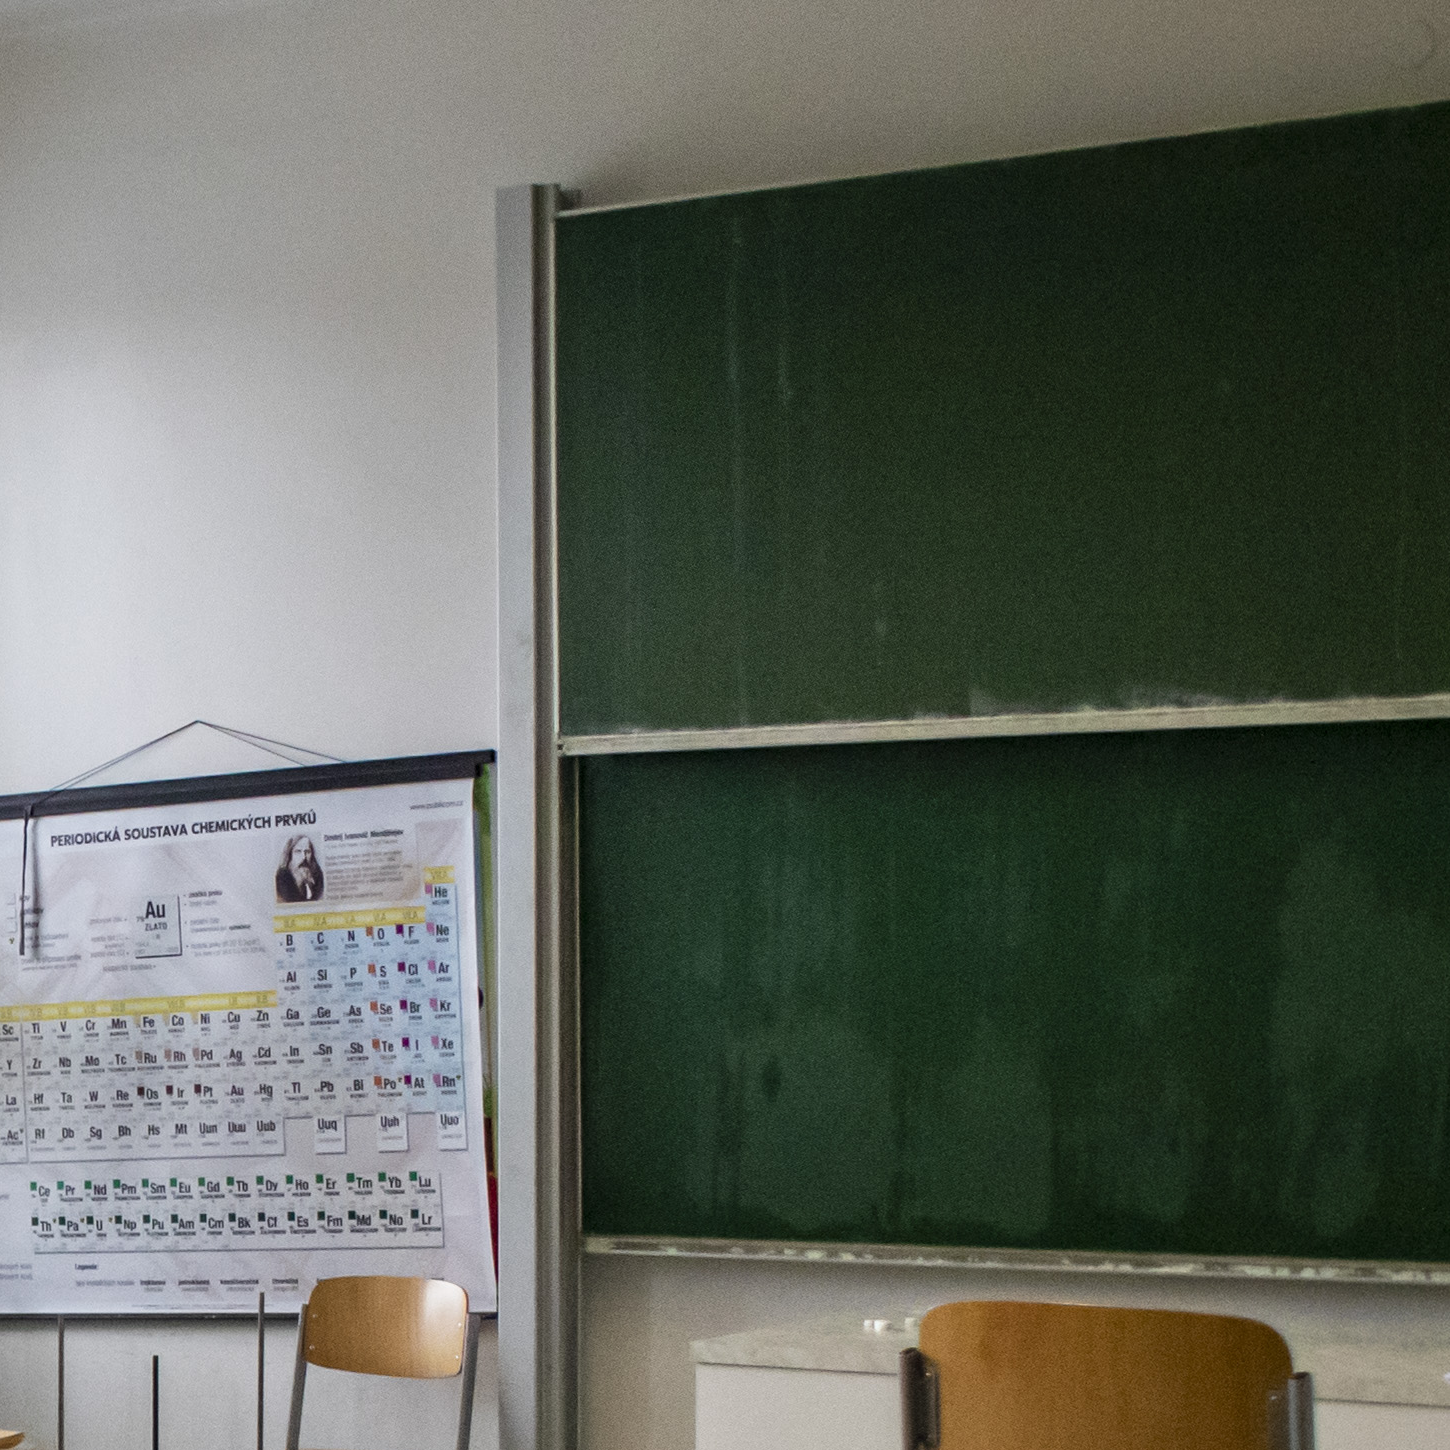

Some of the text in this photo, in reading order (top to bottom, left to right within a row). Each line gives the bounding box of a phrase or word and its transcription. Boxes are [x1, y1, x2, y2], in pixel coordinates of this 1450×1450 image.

[50, 826, 121, 847] PERIODICKÁ
[124, 824, 188, 841] SOUSTAVA
[191, 814, 271, 835] CHEMICKÝCH
[434, 886, 448, 898] He
[145, 901, 166, 919] Au
[144, 922, 168, 932] ZLATO
[286, 924, 449, 946] B C N O F Ne
[286, 972, 296, 983] Al
[317, 969, 328, 981] Si
[350, 967, 357, 979] P
[380, 965, 387, 977] S
[438, 962, 449, 974] Ar
[2, 1024, 14, 1036] Sc
[60, 1021, 67, 1033] V
[85, 1019, 96, 1031] Cr
[111, 1018, 127, 1029] Mn
[143, 1016, 155, 1028] Fe
[171, 1015, 184, 1026] Co
[200, 1013, 210, 1025] Ni
[227, 1012, 241, 1023] Cu
[256, 1010, 269, 1022] Zn
[286, 1008, 300, 1020] Ga
[317, 1007, 331, 1018] Ge
[349, 1005, 362, 1017] As
[379, 1003, 393, 1015] Se
[409, 1001, 421, 1013] Br
[440, 1000, 451, 1012] Kr
[6, 1059, 12, 1071] Y
[32, 1058, 42, 1070] Zr
[58, 1056, 71, 1068] Nb
[85, 1055, 100, 1067] Mo
[115, 1054, 127, 1065] Tc
[143, 1052, 157, 1064] Ru
[173, 1051, 186, 1063] Rh
[201, 1050, 213, 1061] Pd
[229, 1048, 243, 1062] Ag
[258, 1047, 271, 1058] Cd
[289, 1045, 299, 1057] In
[318, 1044, 333, 1055] Sn
[350, 1042, 364, 1054] Sb
[381, 1041, 394, 1052] Te
[441, 1037, 454, 1049] Xe
[5, 1094, 17, 1105] La
[61, 1092, 73, 1103] Ta
[88, 1091, 99, 1102] W
[116, 1089, 130, 1100] Re
[145, 1088, 159, 1100] Os
[230, 1085, 244, 1096] Au
[259, 1083, 273, 1098] Hg
[320, 1081, 334, 1093] Pb
[384, 1078, 396, 1090] Po
[413, 1077, 425, 1089] At
[442, 1075, 456, 1087] Rn
[7, 1129, 19, 1140] Ac
[62, 1127, 75, 1138] Db
[90, 1126, 102, 1140] Sg
[118, 1125, 131, 1136] Bh
[148, 1124, 161, 1135] Hs
[257, 1119, 276, 1132] Uub
[380, 1115, 400, 1127] Uuh
[38, 1185, 50, 1197] Ce
[65, 1184, 75, 1196] Pr
[121, 1183, 137, 1195] Pm
[150, 1182, 166, 1194] Sm
[179, 1182, 191, 1193] Eu
[206, 1181, 220, 1193] Gd
[236, 1180, 248, 1192] Tb
[265, 1179, 278, 1193] Dy
[295, 1178, 309, 1190] Ho
[326, 1178, 337, 1190] Er
[357, 1177, 373, 1189] Tm
[388, 1176, 401, 1188] Yb
[418, 1176, 431, 1187] Lu
[40, 1221, 51, 1232] Th
[67, 1220, 79, 1232] Pa
[152, 1219, 164, 1230] Pu
[178, 1218, 195, 1229] Am
[208, 1217, 224, 1229] Cm
[238, 1217, 251, 1228] Bk
[297, 1215, 309, 1227] Es
[327, 1215, 343, 1227] Fm
[389, 1214, 403, 1226] No
[422, 1213, 432, 1225] Lr
